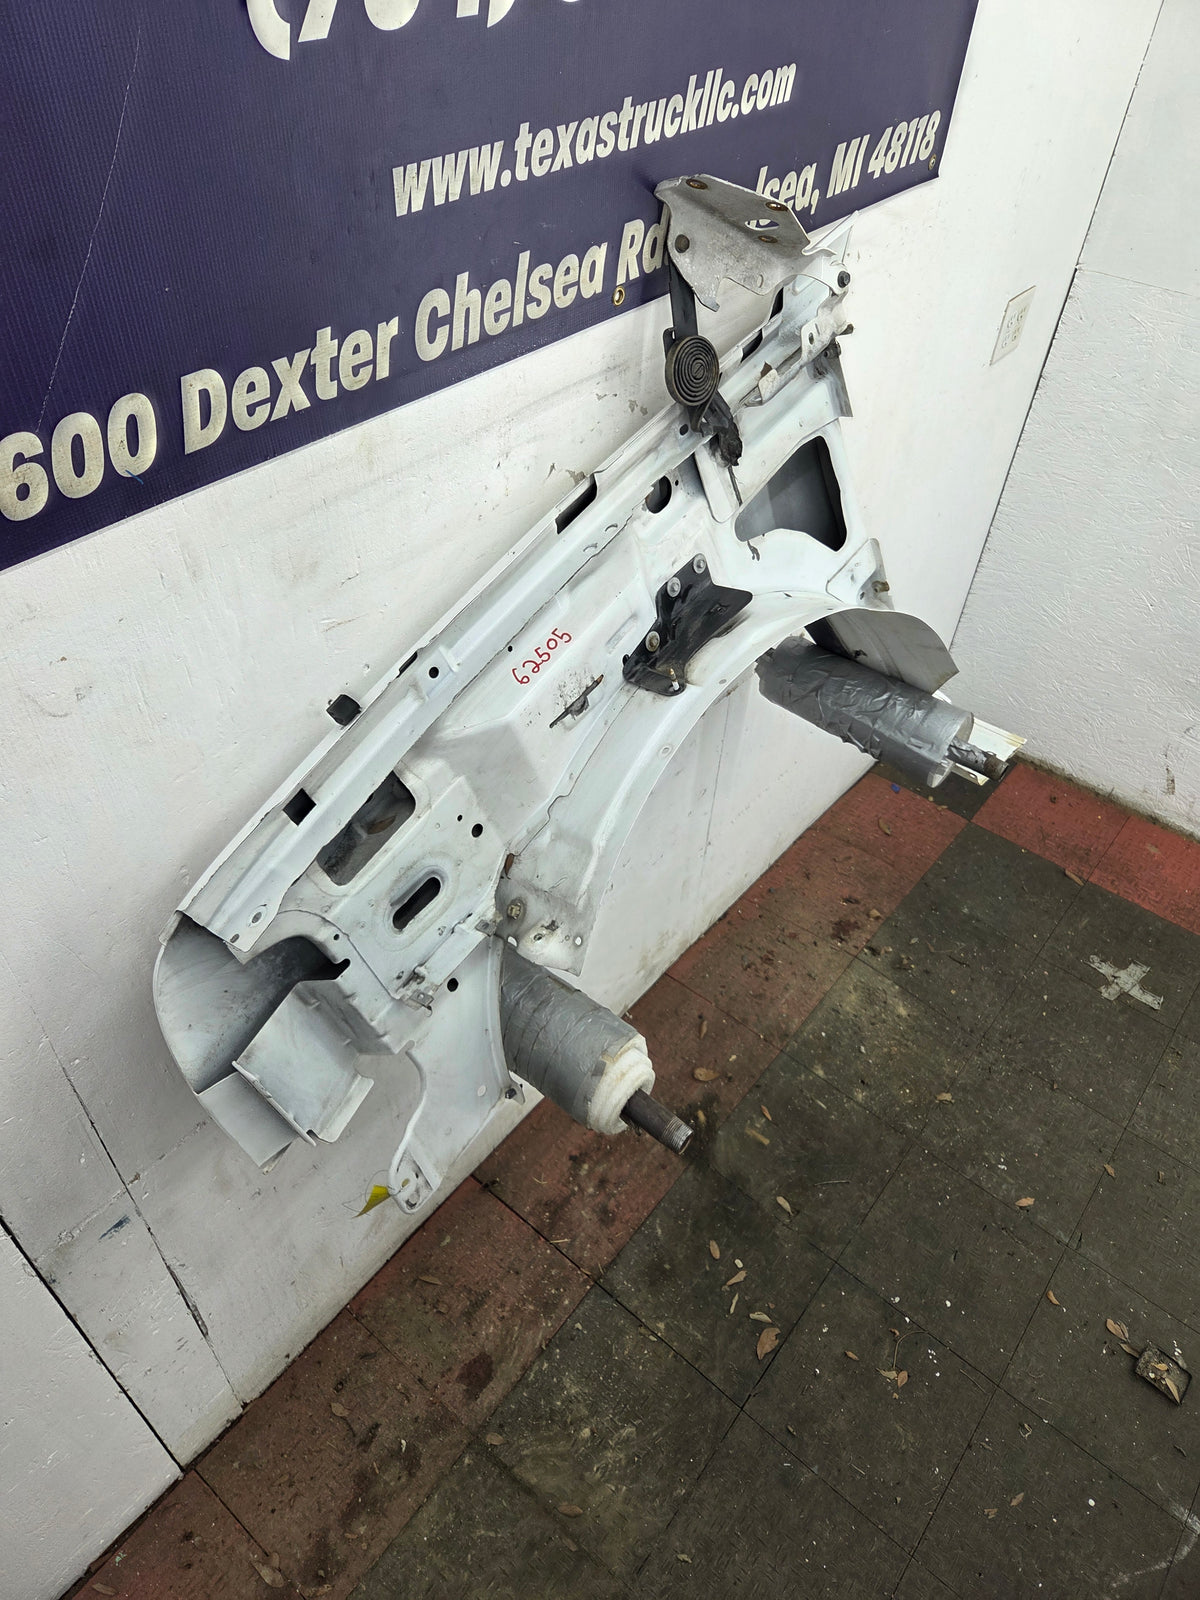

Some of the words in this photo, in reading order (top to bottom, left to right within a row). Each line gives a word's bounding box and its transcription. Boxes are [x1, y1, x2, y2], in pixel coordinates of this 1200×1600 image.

[392, 63, 797, 217] www.texastruckllc.com
[180, 316, 399, 455] Dexter
[415, 242, 609, 362] Chelsea
[826, 134, 871, 198] MI
[867, 109, 942, 180] 48118
[511, 627, 573, 685] 62505
